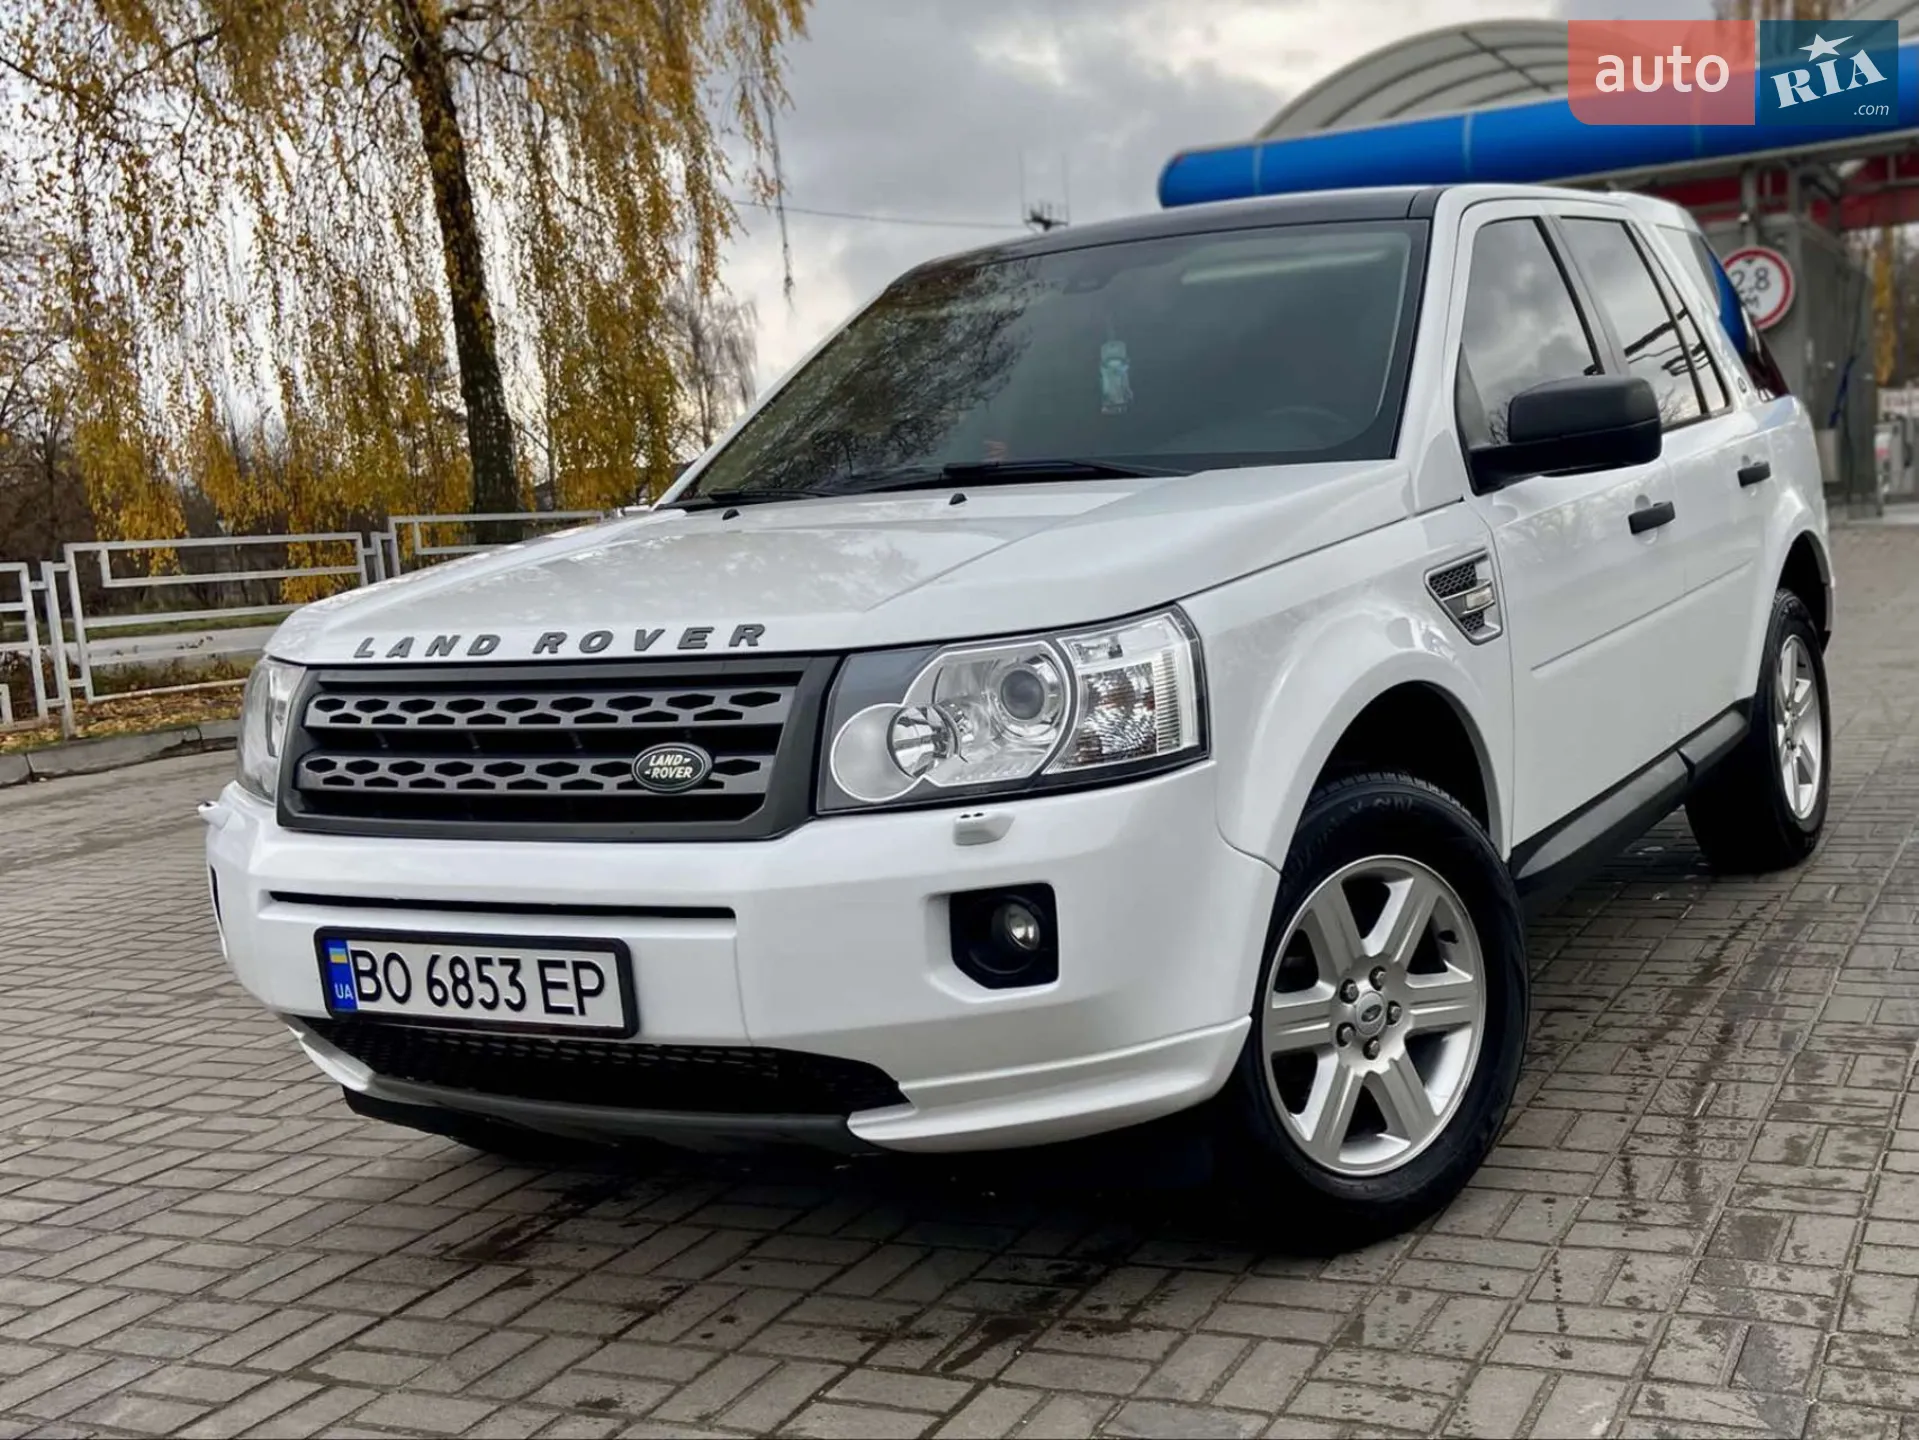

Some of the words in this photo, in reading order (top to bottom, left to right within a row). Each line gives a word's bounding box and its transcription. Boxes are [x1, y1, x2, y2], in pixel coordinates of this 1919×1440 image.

[353, 634, 502, 659] LAND
[531, 623, 766, 655] ROVER
[648, 754, 684, 767] LAND
[650, 766, 694, 780] ROVER
[350, 948, 412, 1005] BO
[426, 953, 527, 1013] 6853
[537, 957, 606, 1016] EP
[334, 983, 354, 1001] UA
